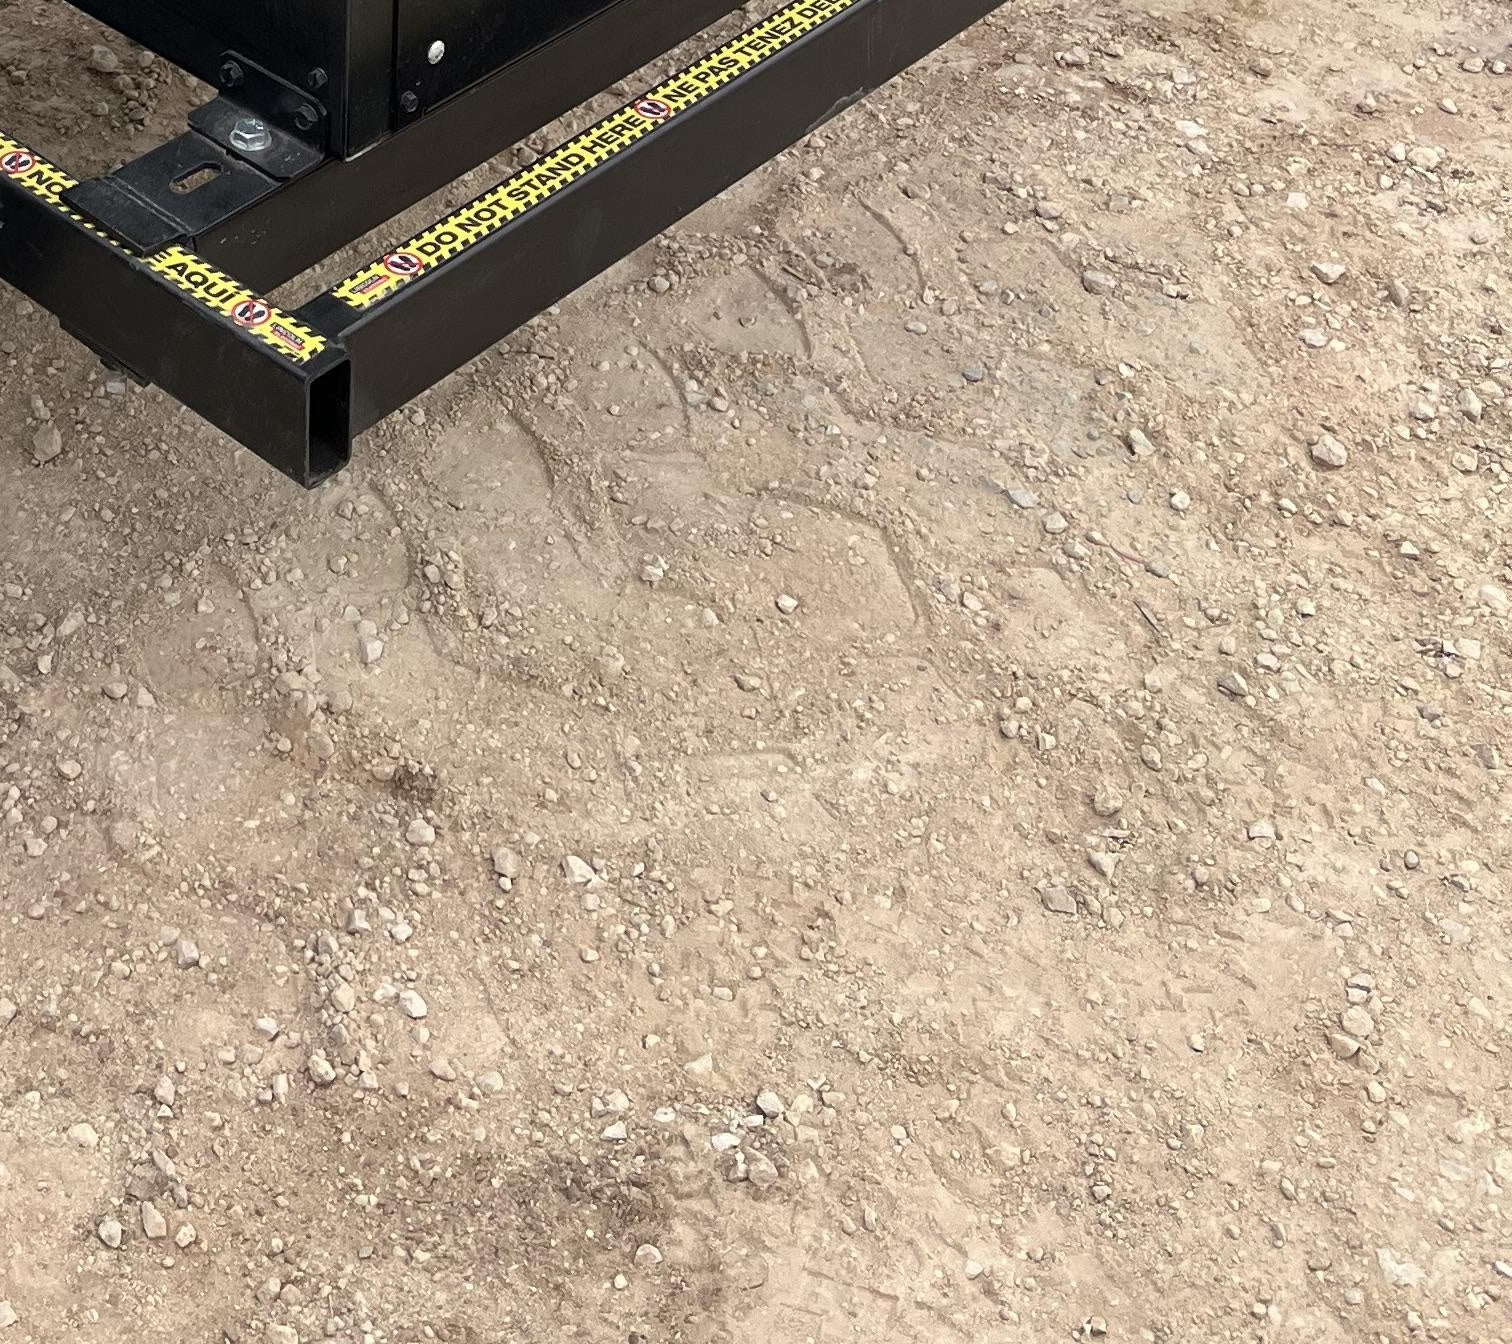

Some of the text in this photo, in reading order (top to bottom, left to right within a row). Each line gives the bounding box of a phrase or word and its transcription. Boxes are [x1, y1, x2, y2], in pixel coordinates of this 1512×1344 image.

[26, 169, 66, 195] NO
[416, 229, 459, 257] DO
[455, 198, 511, 235] NOT
[506, 152, 586, 202] STAND
[583, 114, 646, 155] HERE
[662, 79, 698, 104] NE
[697, 56, 740, 84] PAS
[732, 19, 804, 58] TENEZ
